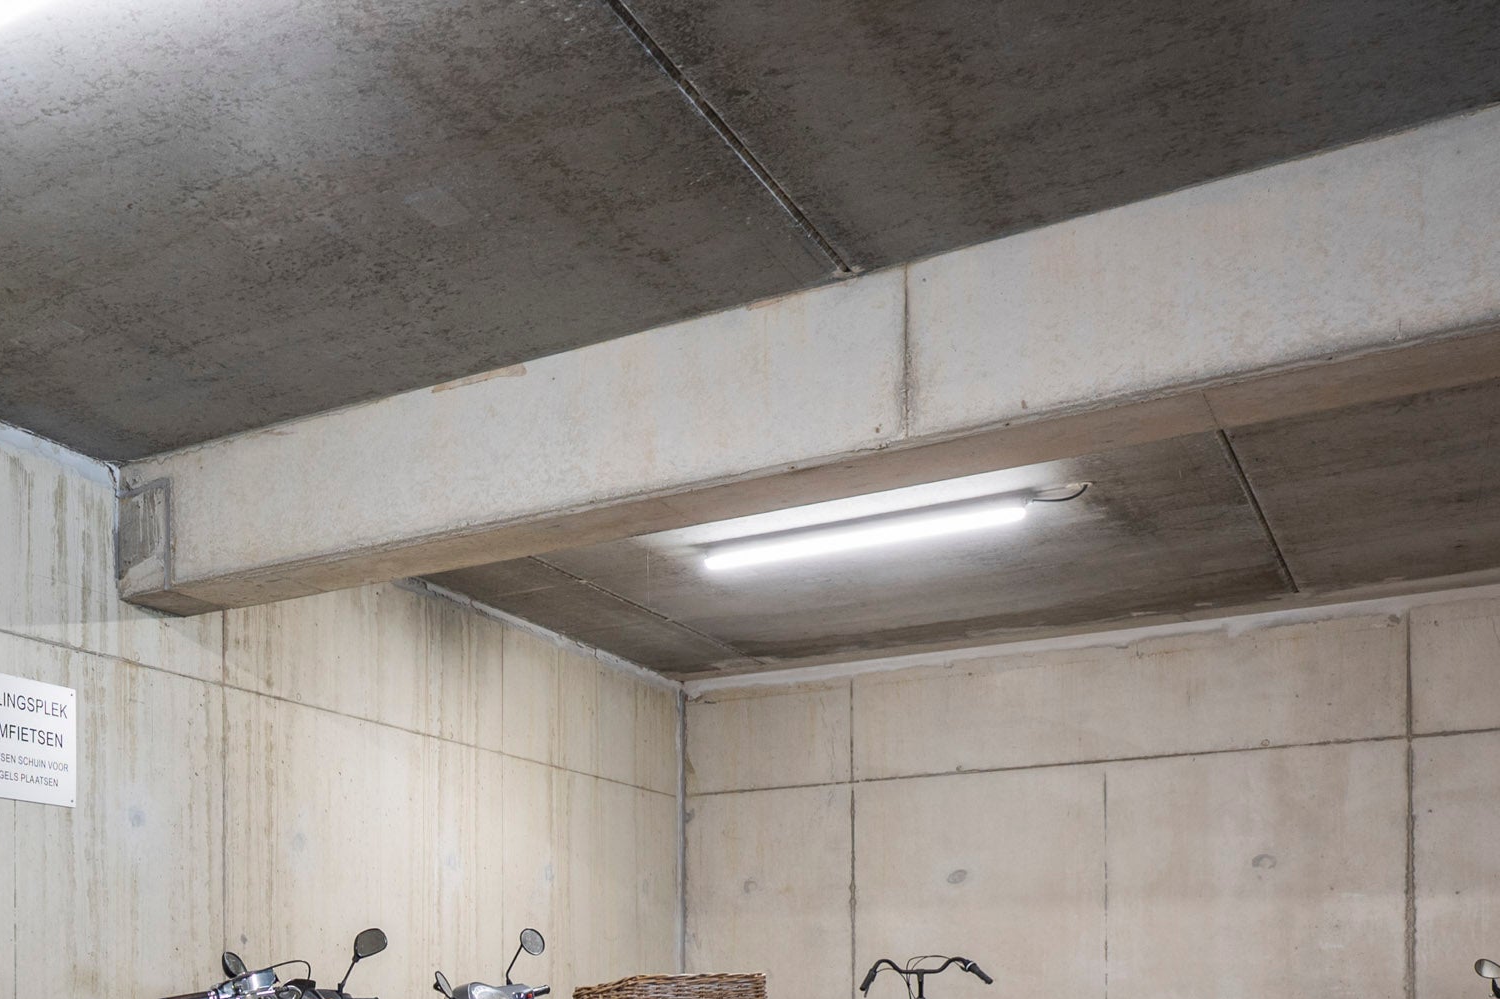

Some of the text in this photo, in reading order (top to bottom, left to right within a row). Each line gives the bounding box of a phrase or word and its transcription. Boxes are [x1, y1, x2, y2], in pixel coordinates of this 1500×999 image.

[18, 756, 46, 769] SCHUIN
[48, 760, 69, 772] VOOR
[20, 773, 59, 787] PLAATSEN
